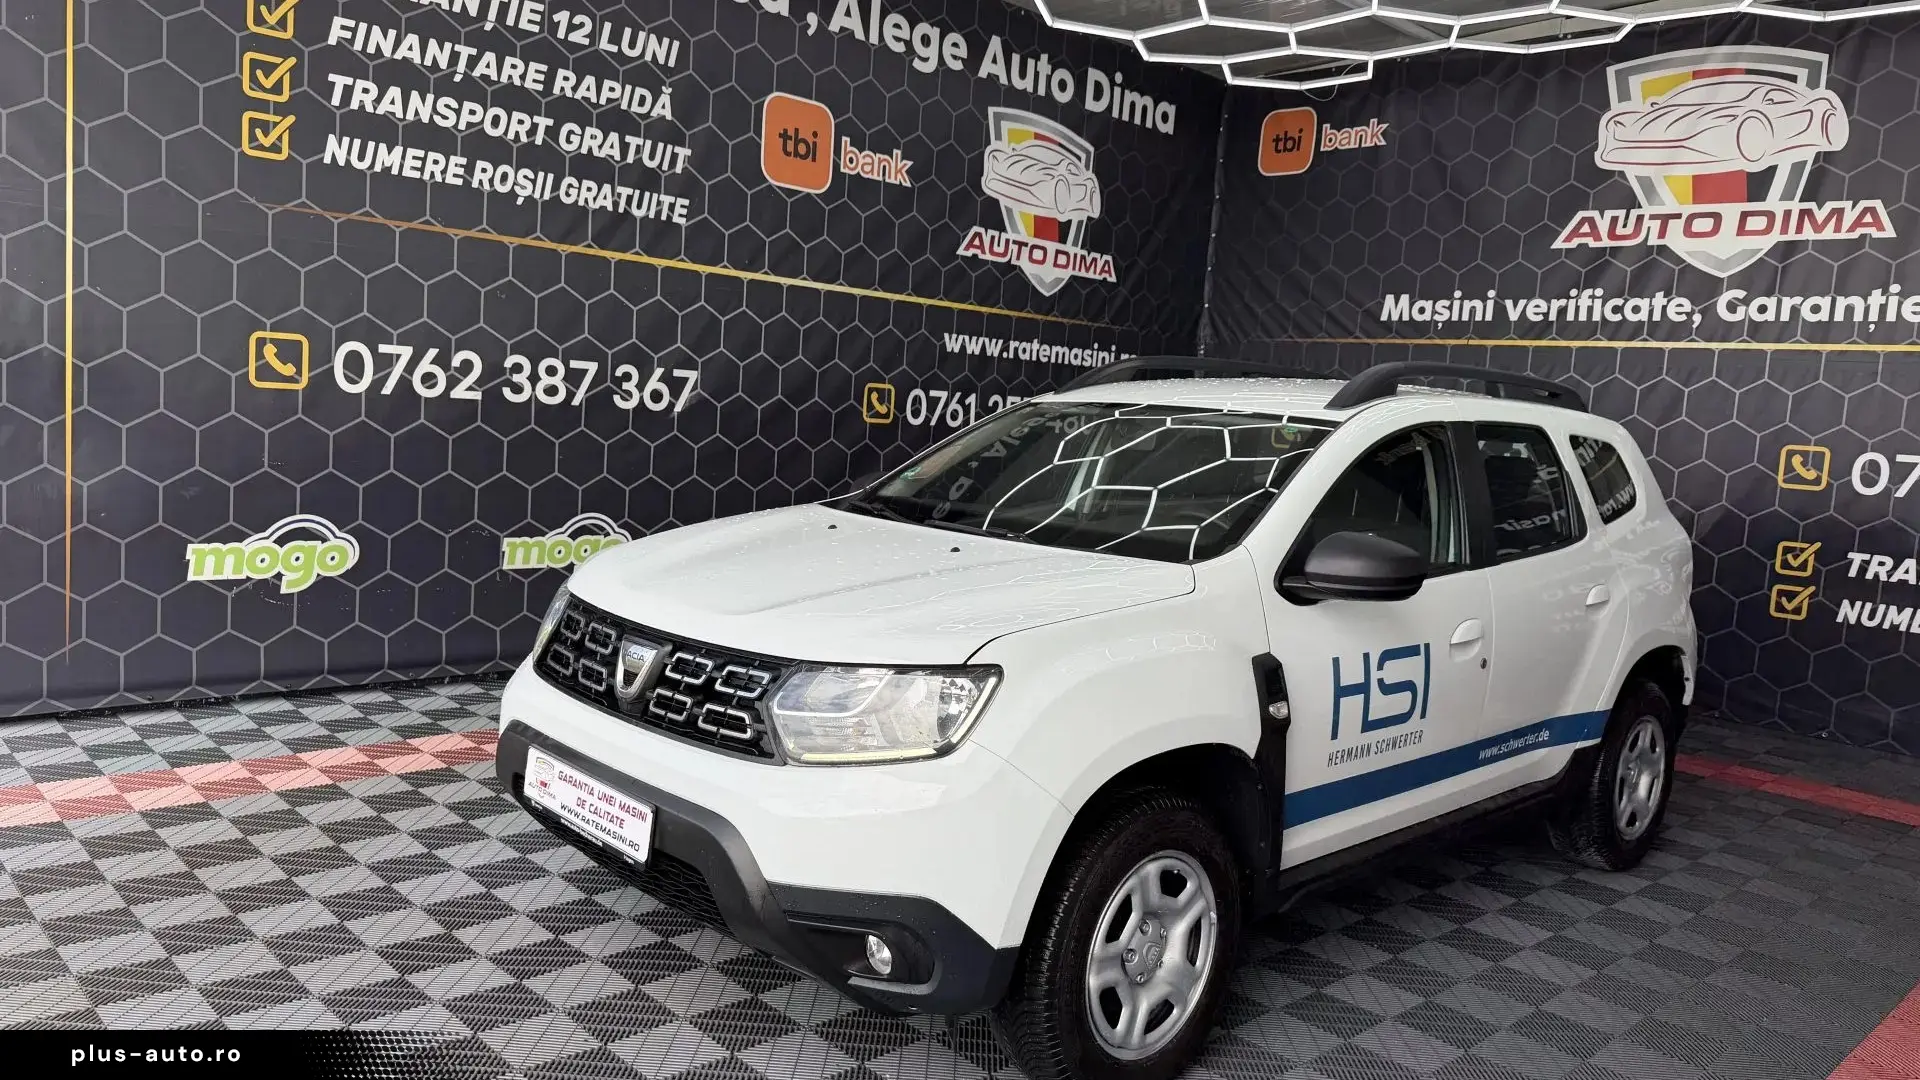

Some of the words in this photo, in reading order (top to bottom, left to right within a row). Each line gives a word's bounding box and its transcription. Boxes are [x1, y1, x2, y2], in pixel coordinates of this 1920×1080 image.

[552, 10, 593, 46] 12
[600, 24, 681, 68] LUNI
[327, 16, 549, 92] FINANȚARE
[552, 67, 675, 121] RAPIDĂ
[828, 0, 969, 73] Alege
[978, 36, 1075, 103] Auto
[1085, 67, 1177, 135] Dima
[326, 73, 554, 147] TRANSPORT
[559, 122, 692, 175] GRATUIT
[1272, 129, 1303, 155] tbi
[1322, 121, 1386, 150] bank
[323, 134, 467, 186] NUMERE
[471, 160, 553, 205] ROȘII
[559, 176, 690, 224] GRATUITE
[779, 127, 819, 164] tbi
[842, 140, 911, 185] bank
[1561, 208, 1727, 244] AUTO
[1735, 204, 1887, 238] DIMA
[963, 230, 1048, 267] AUTO
[1052, 251, 1114, 279] DIMA
[1380, 289, 1497, 331] Mașini
[1504, 287, 1703, 327] verificate,
[1715, 284, 1920, 333] Garanție
[333, 340, 483, 401] 0762
[501, 354, 599, 407] 387
[613, 363, 699, 412] 367
[905, 388, 977, 429] 0761
[188, 536, 354, 592] mogo
[505, 538, 624, 566] mog
[1847, 551, 1920, 586] TRA
[1330, 642, 1431, 741] HSI
[1327, 741, 1373, 768] HERMANN
[1374, 729, 1425, 756] SCHWERTER
[1478, 728, 1550, 760] www.schwerter.de
[557, 769, 596, 798] GARANTIA
[597, 789, 617, 806] UNEI
[618, 800, 648, 824] MASINI
[576, 796, 588, 810] DE
[588, 803, 626, 830] CALITATE
[560, 801, 641, 853] WWW.RATEMASINI.RO
